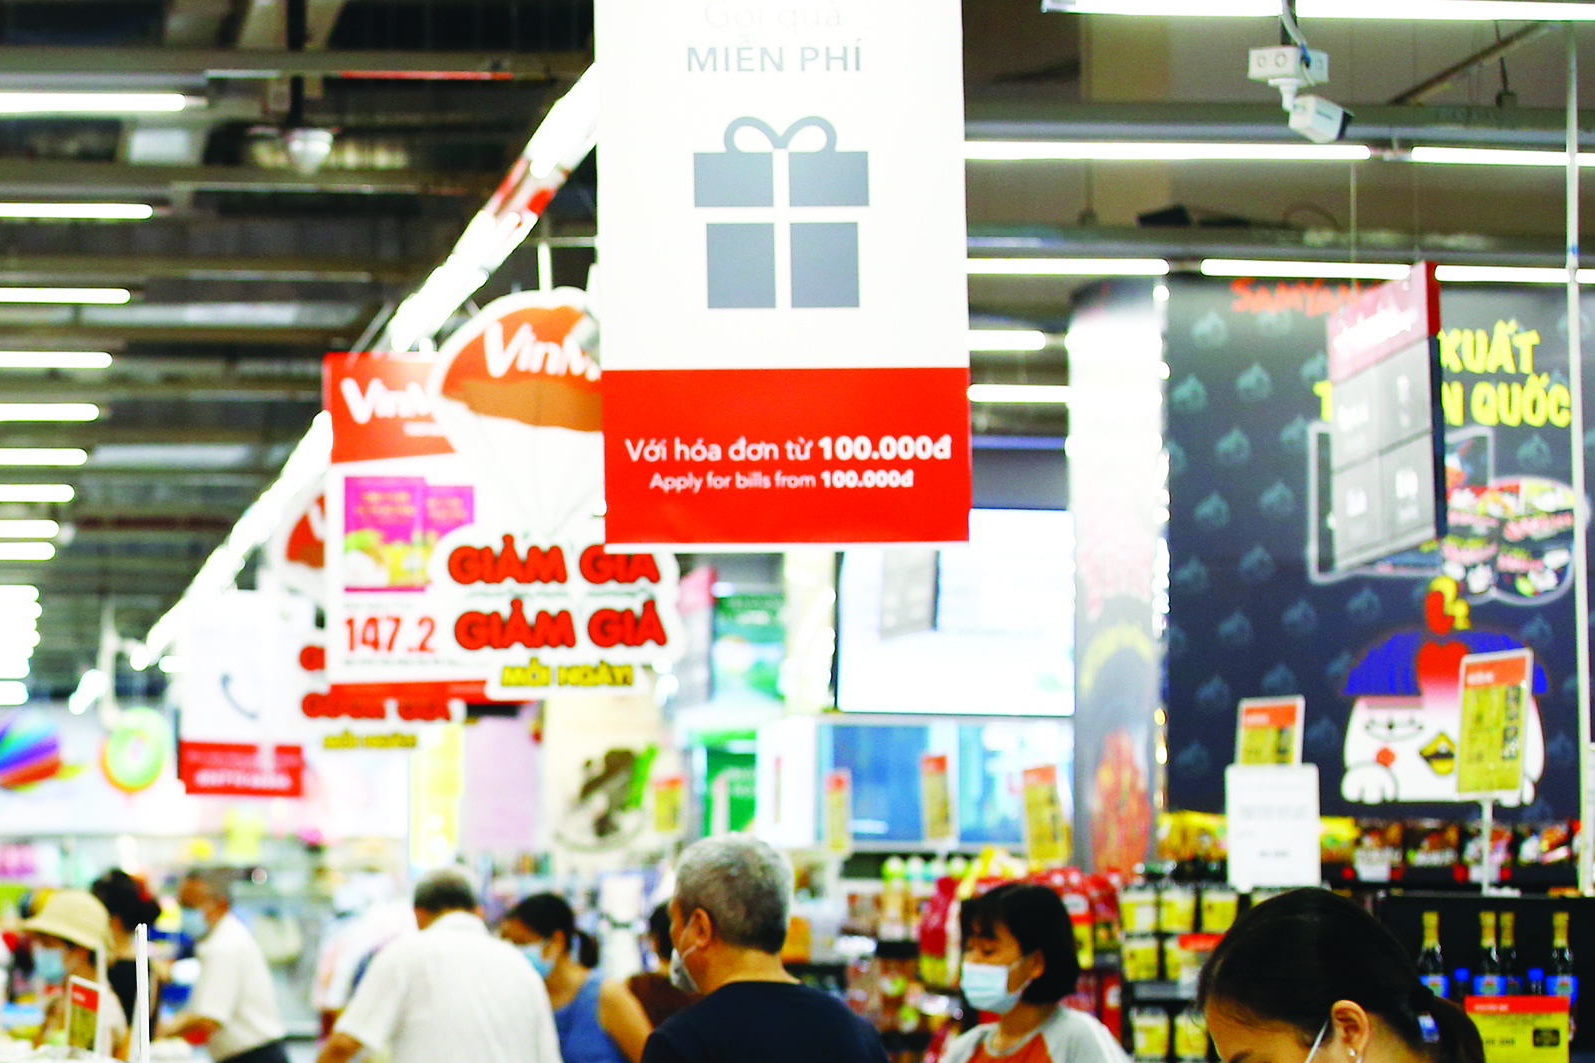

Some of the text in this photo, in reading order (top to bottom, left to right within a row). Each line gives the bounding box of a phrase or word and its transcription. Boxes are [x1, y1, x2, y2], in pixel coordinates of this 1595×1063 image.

[687, 33, 863, 73] MIỄN PHÍ
[624, 434, 953, 462] Với hóa đơn từ 100.000đ
[650, 468, 915, 494] Apply for bills from 100.000đ
